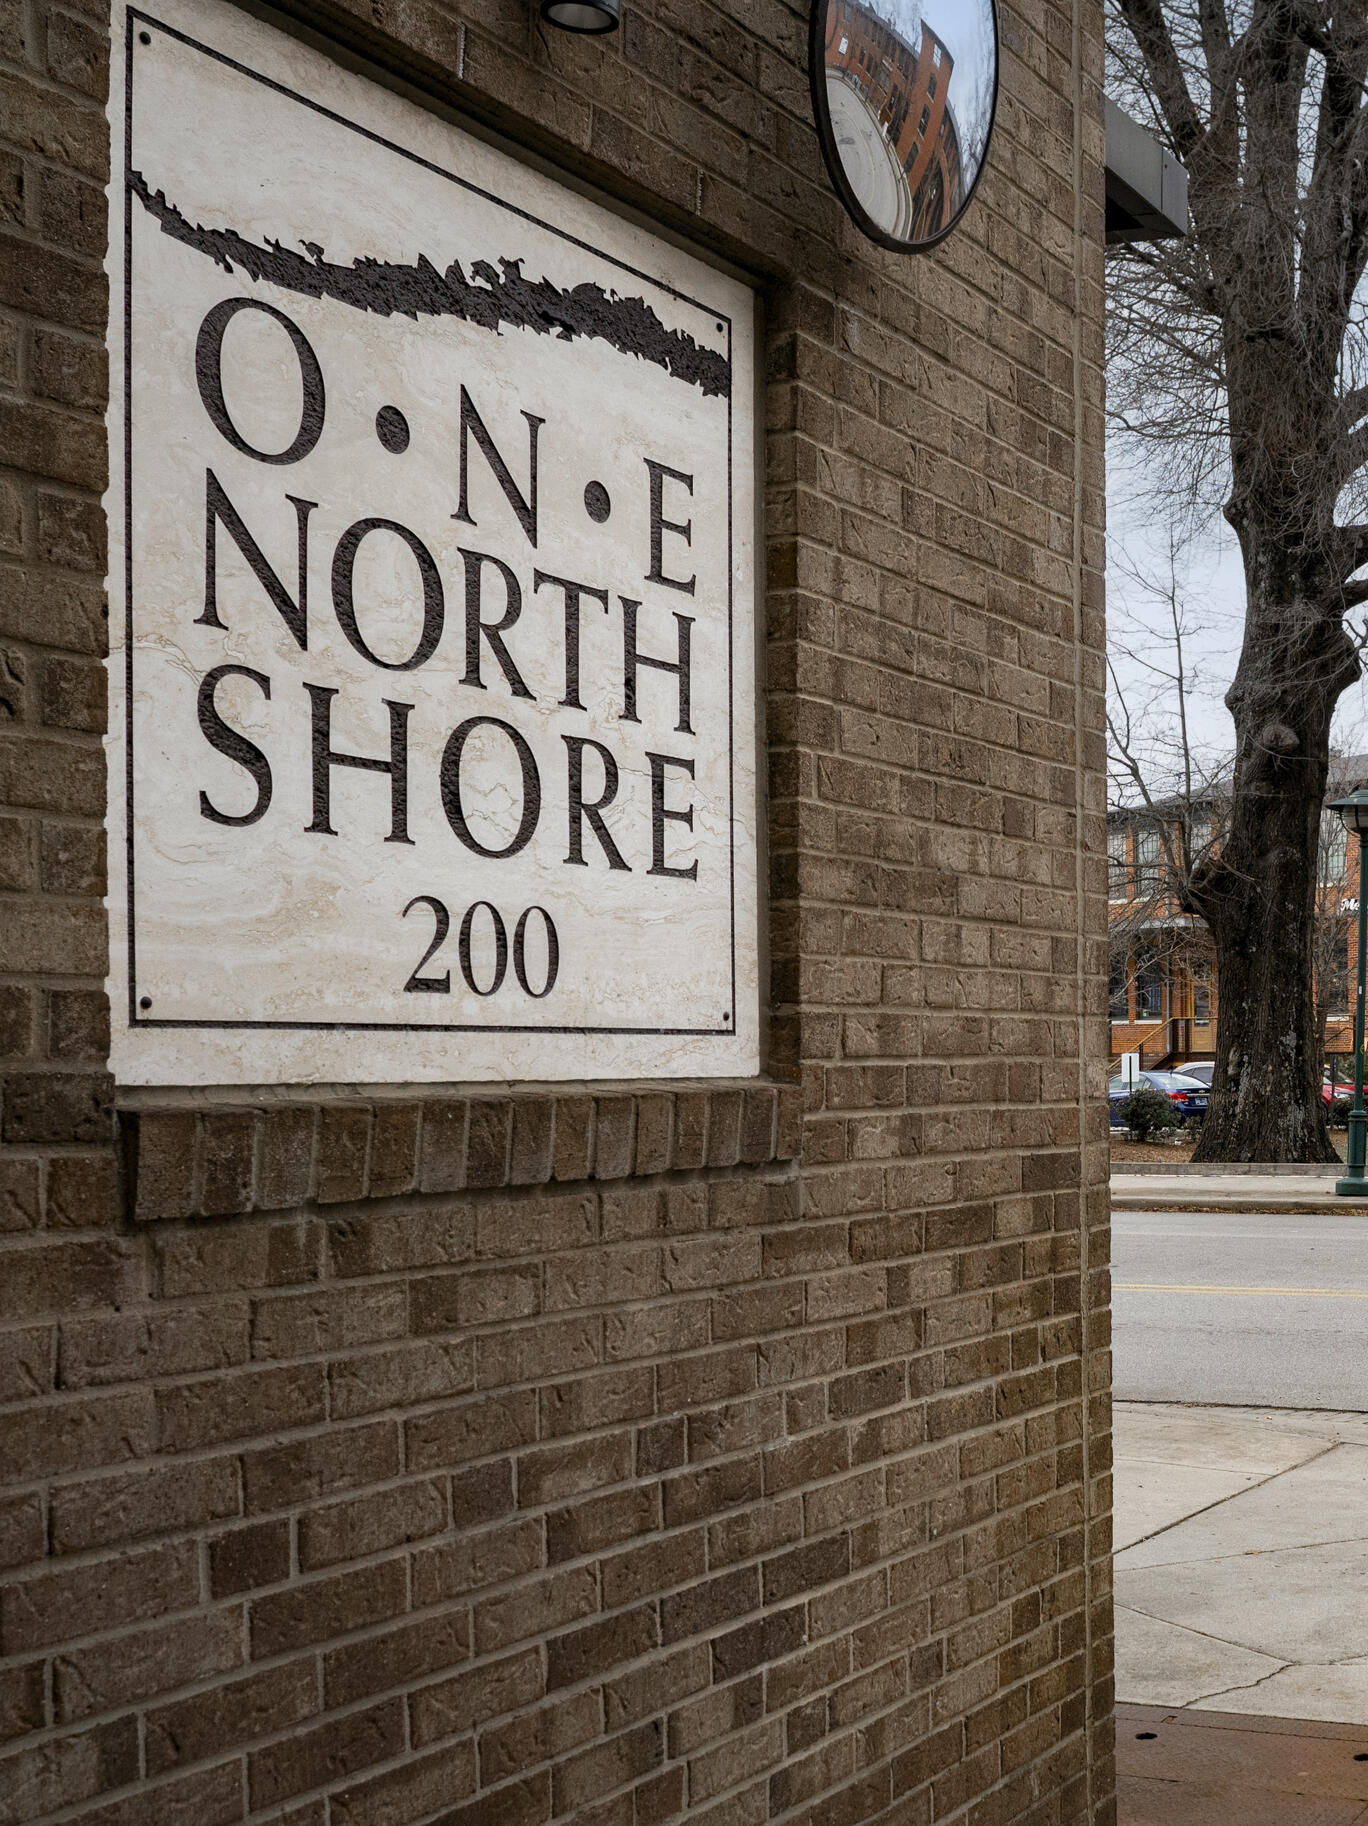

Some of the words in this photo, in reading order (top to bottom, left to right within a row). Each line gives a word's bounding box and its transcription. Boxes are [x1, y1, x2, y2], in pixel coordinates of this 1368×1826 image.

[193, 467, 697, 737] NORTH
[198, 664, 699, 883] SHORE
[402, 895, 560, 999] 200
